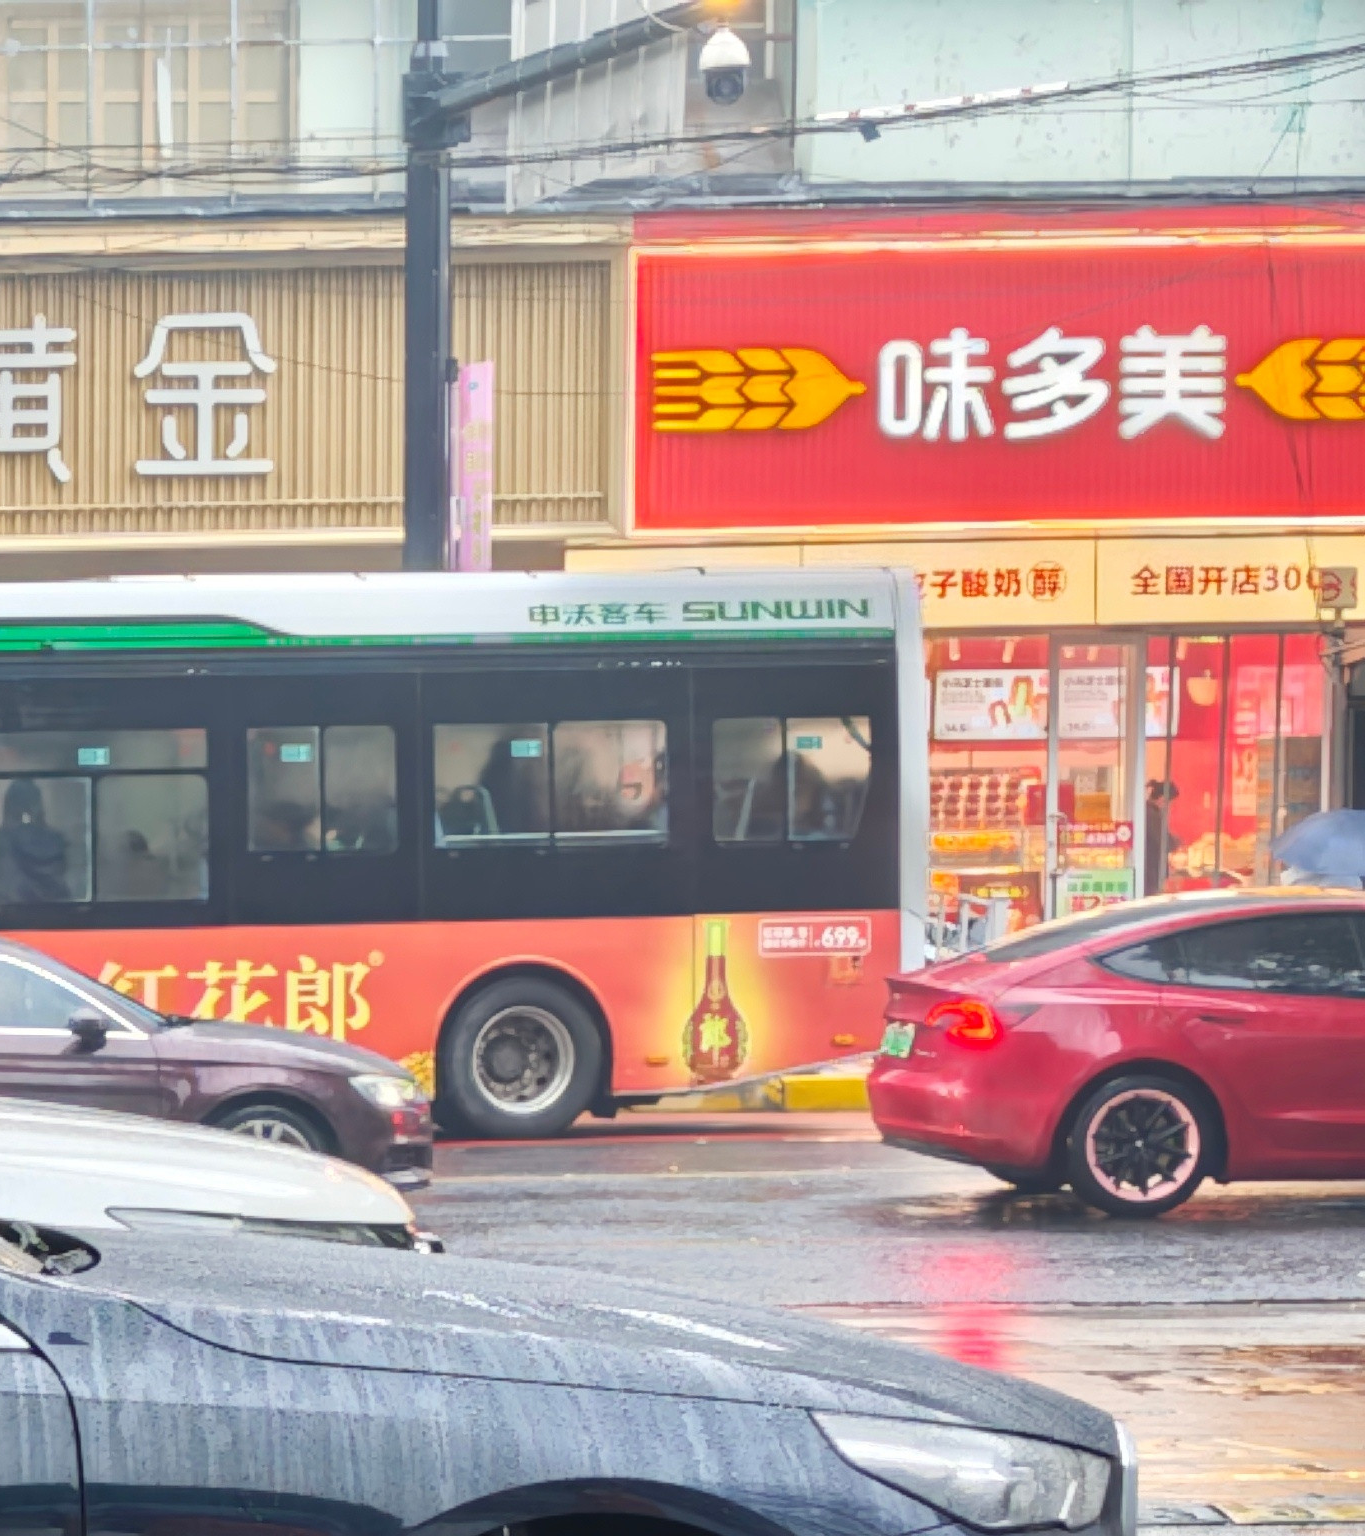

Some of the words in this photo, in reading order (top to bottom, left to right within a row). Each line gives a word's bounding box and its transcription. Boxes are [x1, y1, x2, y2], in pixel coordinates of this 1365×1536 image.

[876, 323, 1228, 443] 味多美
[529, 602, 669, 626] 申沃客车
[682, 598, 870, 622] SUNWIN
[822, 926, 860, 948] 699
[98, 955, 370, 1042] 红花郎
